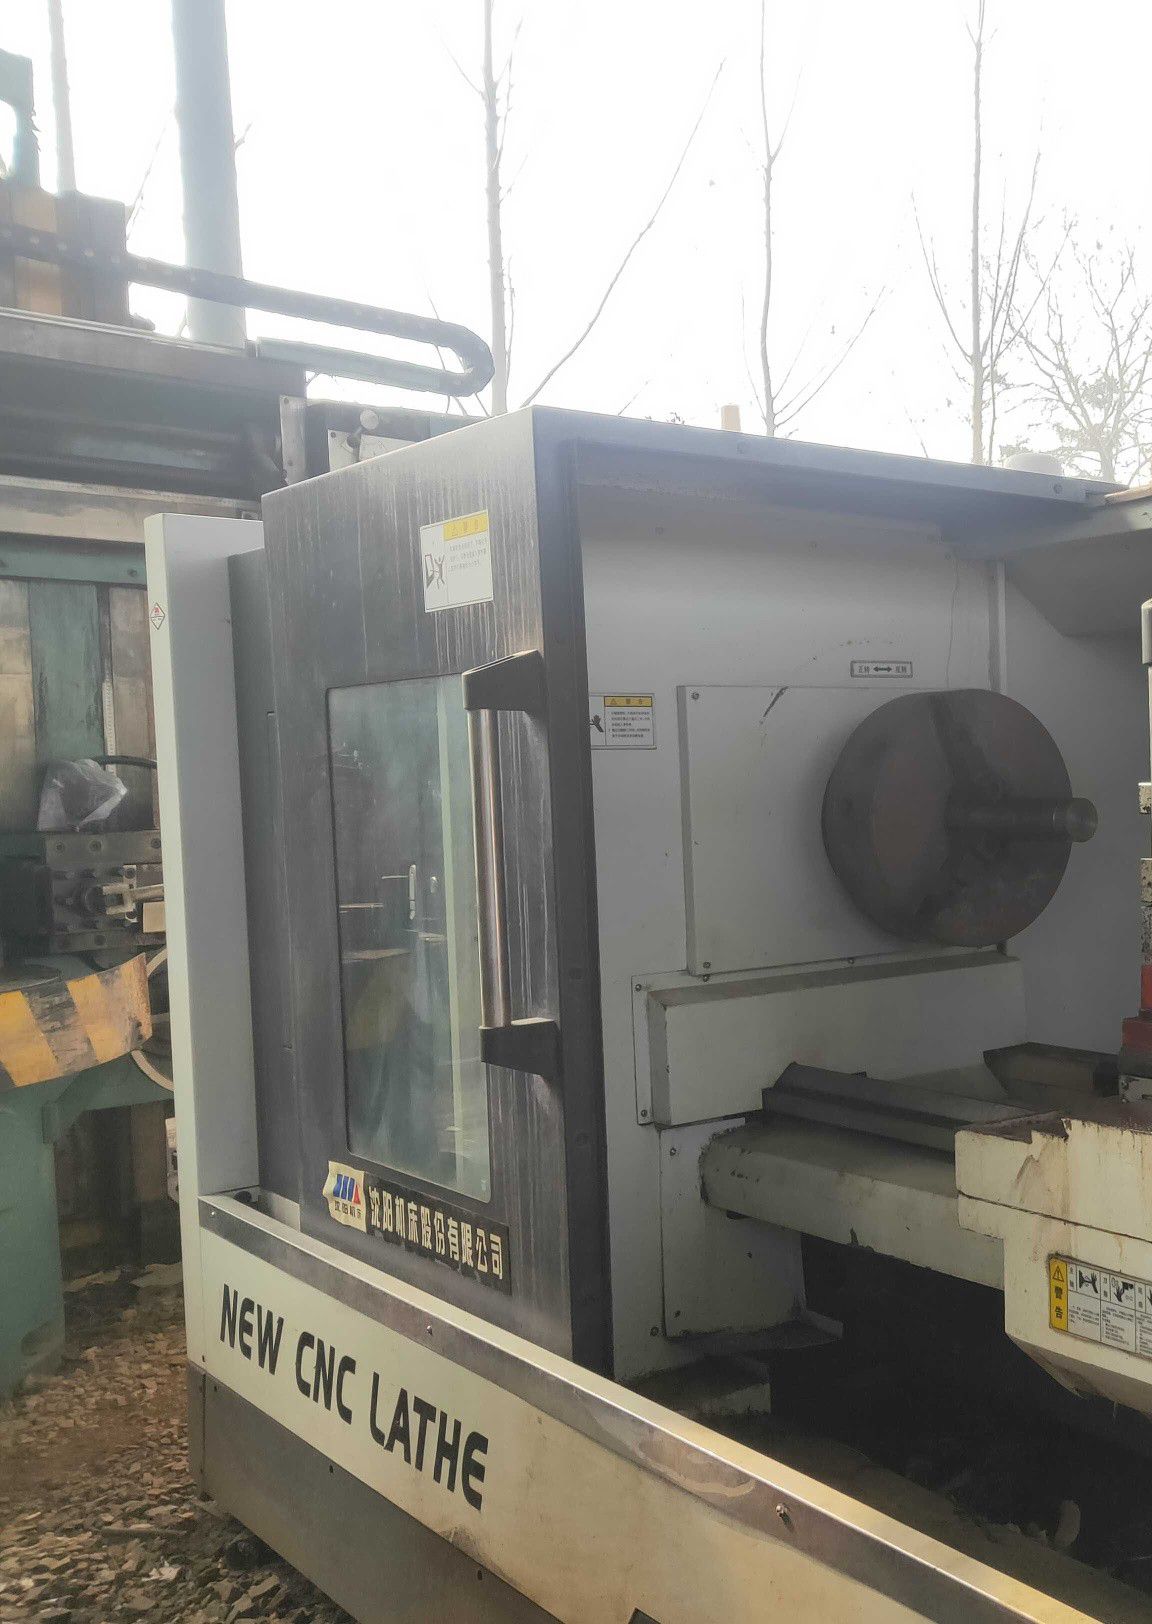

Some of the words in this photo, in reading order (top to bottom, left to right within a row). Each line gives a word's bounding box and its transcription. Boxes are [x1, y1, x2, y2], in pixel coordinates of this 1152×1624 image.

[220, 1283, 284, 1375] NEW
[295, 1330, 357, 1425] CNC
[369, 1371, 490, 1510] LATHE
